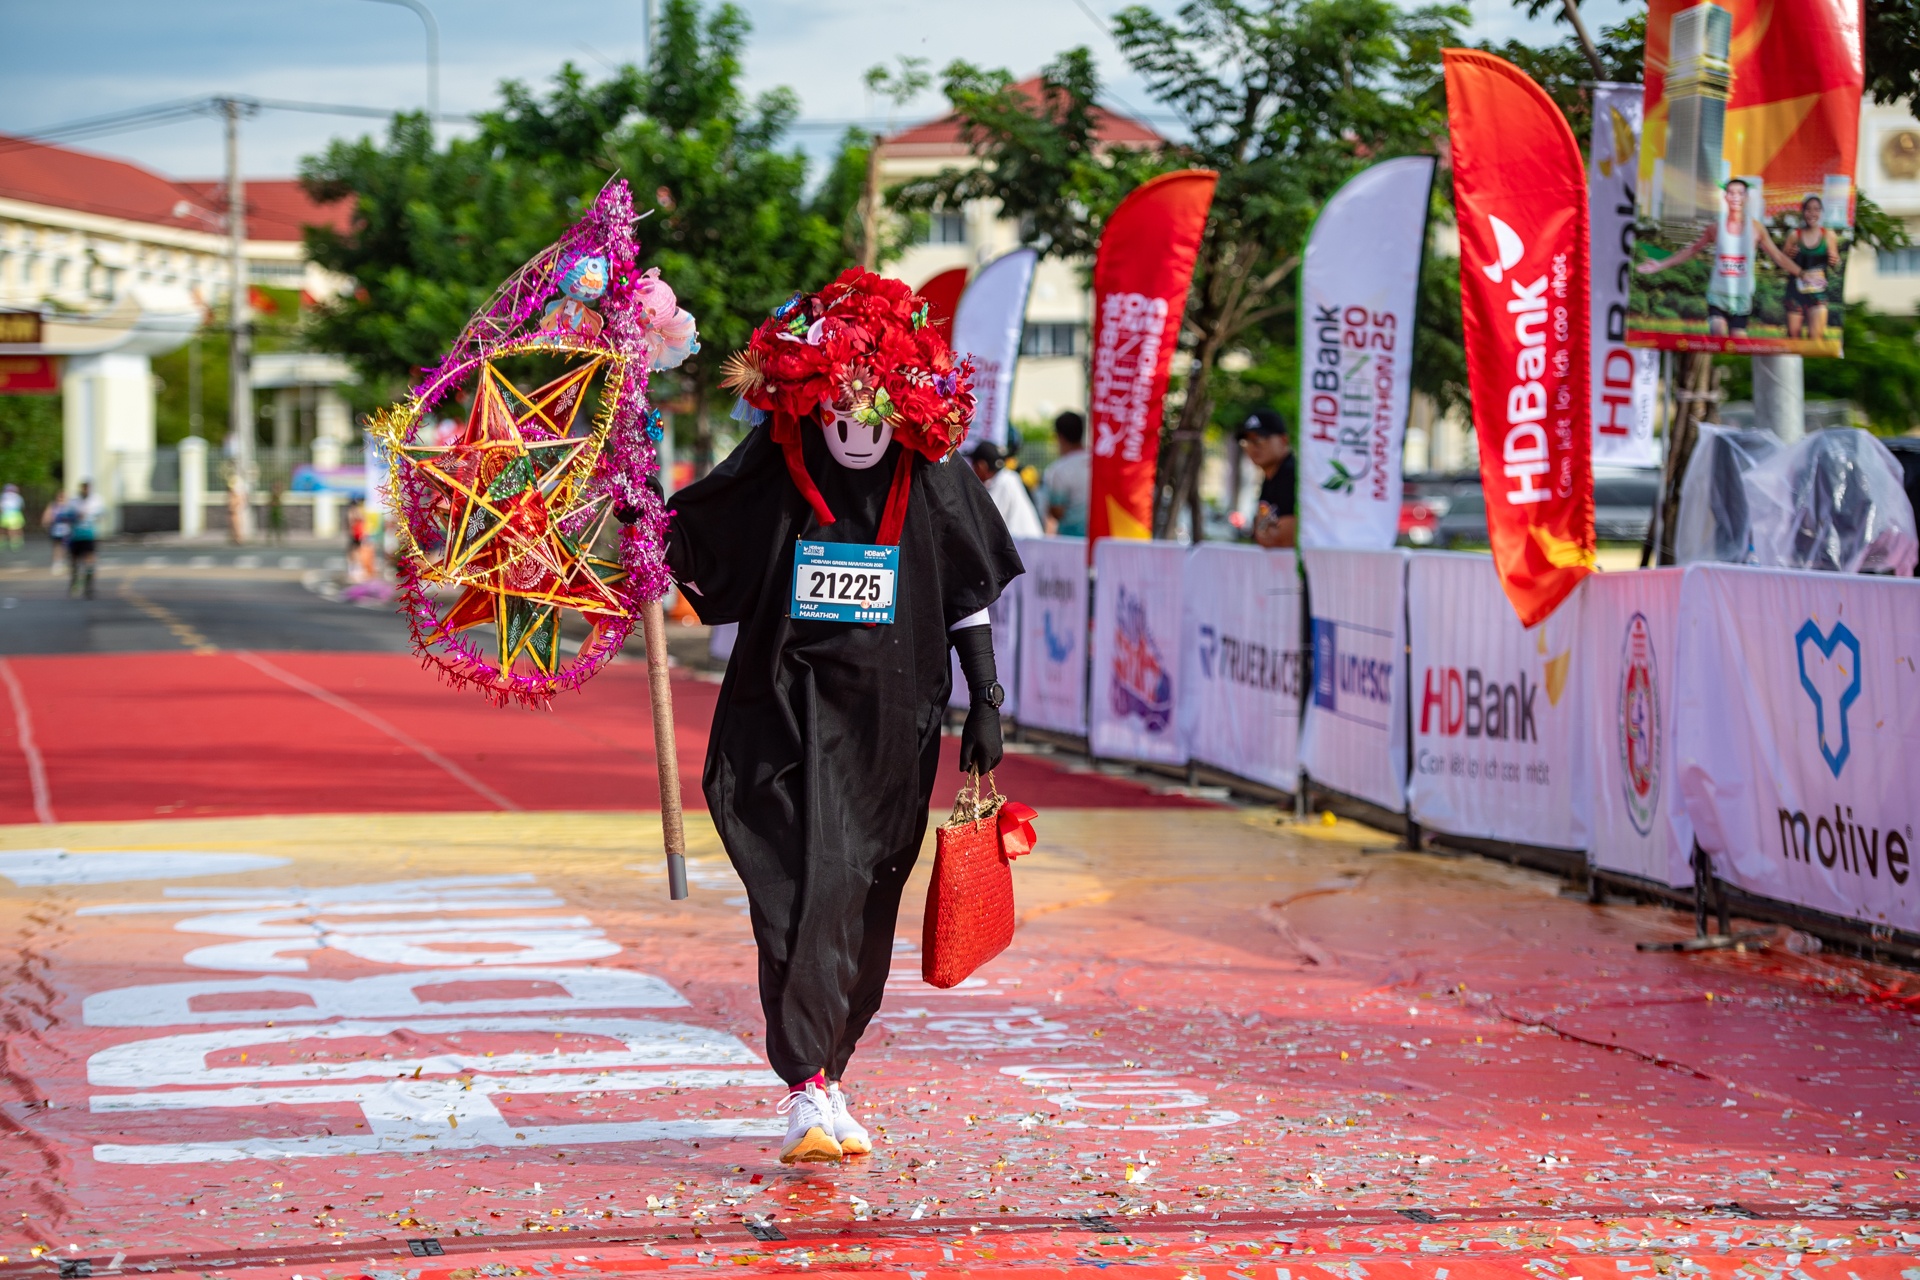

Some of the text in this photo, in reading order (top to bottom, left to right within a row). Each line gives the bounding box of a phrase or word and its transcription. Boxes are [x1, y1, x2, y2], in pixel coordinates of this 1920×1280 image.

[1312, 303, 1341, 443] HDBank
[1554, 306, 1569, 343] cao
[1333, 306, 1373, 480] GREEN 20
[1371, 311, 1396, 501] MARATHON 25
[1503, 275, 1552, 505] HDBank
[799, 611, 839, 619] MARATHON
[810, 571, 881, 601] 21225
[1419, 666, 1537, 744] HDBank
[1778, 804, 1909, 885] motive
[75, 873, 790, 1164] HDBank
